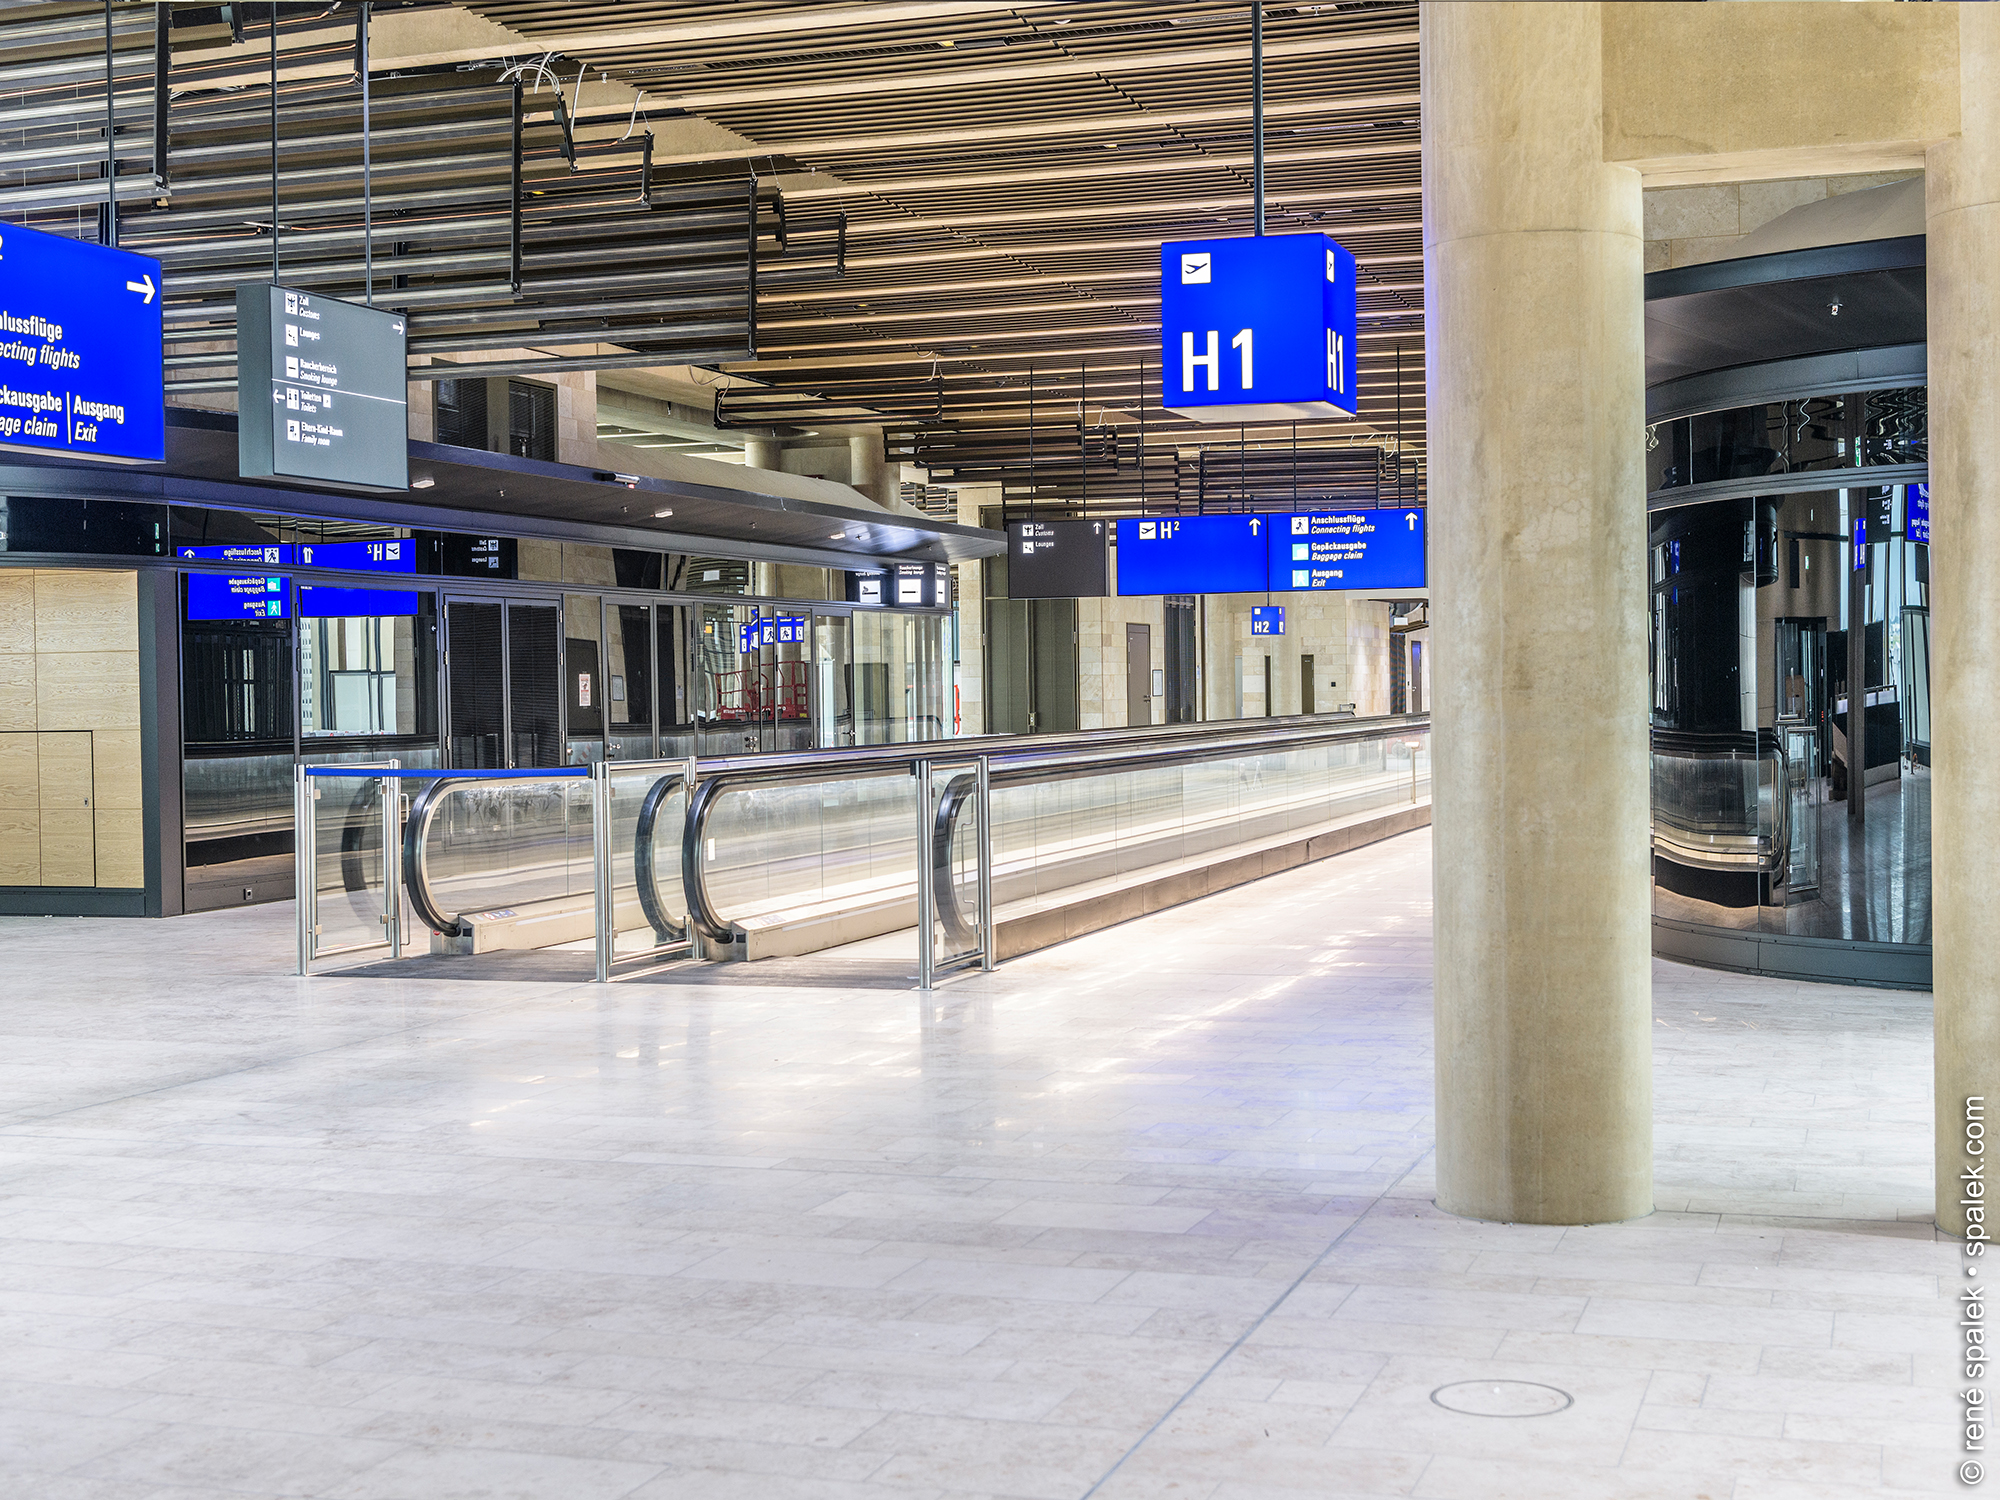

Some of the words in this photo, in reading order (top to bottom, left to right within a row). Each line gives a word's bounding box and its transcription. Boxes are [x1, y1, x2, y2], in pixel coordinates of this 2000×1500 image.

[299, 326, 320, 340] Lounges
[40, 344, 80, 370] flights
[1181, 328, 1253, 392] H1
[1326, 327, 1344, 394] H1
[300, 358, 337, 374] Raucherbereich
[300, 370, 320, 384] Smoking
[321, 374, 338, 387] lounge
[300, 389, 322, 402] Toiletten
[73, 394, 124, 425] Ausgang
[301, 402, 317, 413] Toilets
[24, 415, 57, 438] claim
[74, 421, 97, 442] Exit
[301, 421, 343, 436] Eltern-Kind-Raum
[301, 433, 317, 446] Family
[317, 437, 330, 446] room
[1311, 515, 1365, 525] Anschlussflüge
[1311, 525, 1351, 535] Connecting
[1351, 524, 1376, 535] flights
[1311, 541, 1367, 552] Gepäckausgabe
[1311, 551, 1342, 562] Baggage
[1343, 550, 1364, 560] claim
[1311, 569, 1344, 579] Ausgang
[1311, 578, 1326, 588] Exit
[1254, 621, 1270, 633] H2
